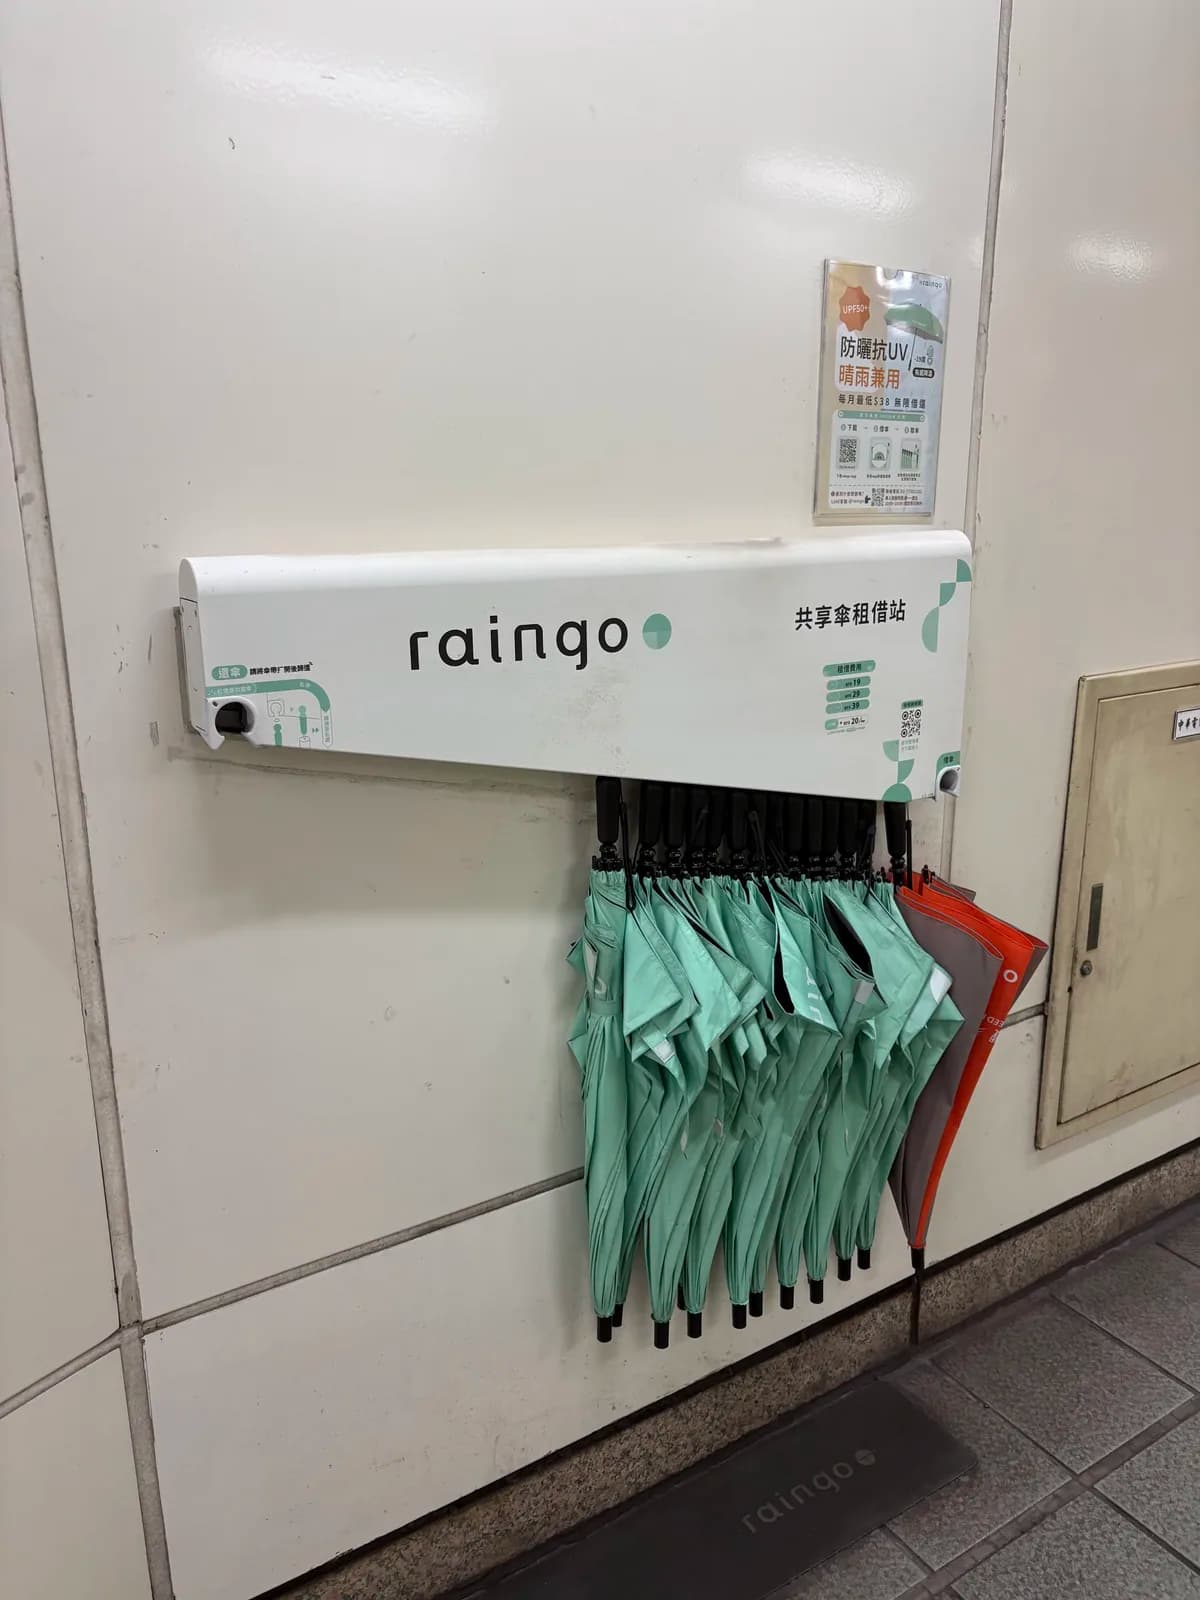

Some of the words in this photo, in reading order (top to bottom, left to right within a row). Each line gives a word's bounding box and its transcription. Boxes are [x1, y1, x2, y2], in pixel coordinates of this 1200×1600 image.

[842, 304, 867, 314] UPF50+
[840, 336, 908, 361] 防曬抗UV
[839, 364, 900, 390] 晴雨兼用
[795, 598, 906, 631] 共享傘租借站
[409, 615, 628, 670] raingo
[740, 1462, 854, 1534] raingo
